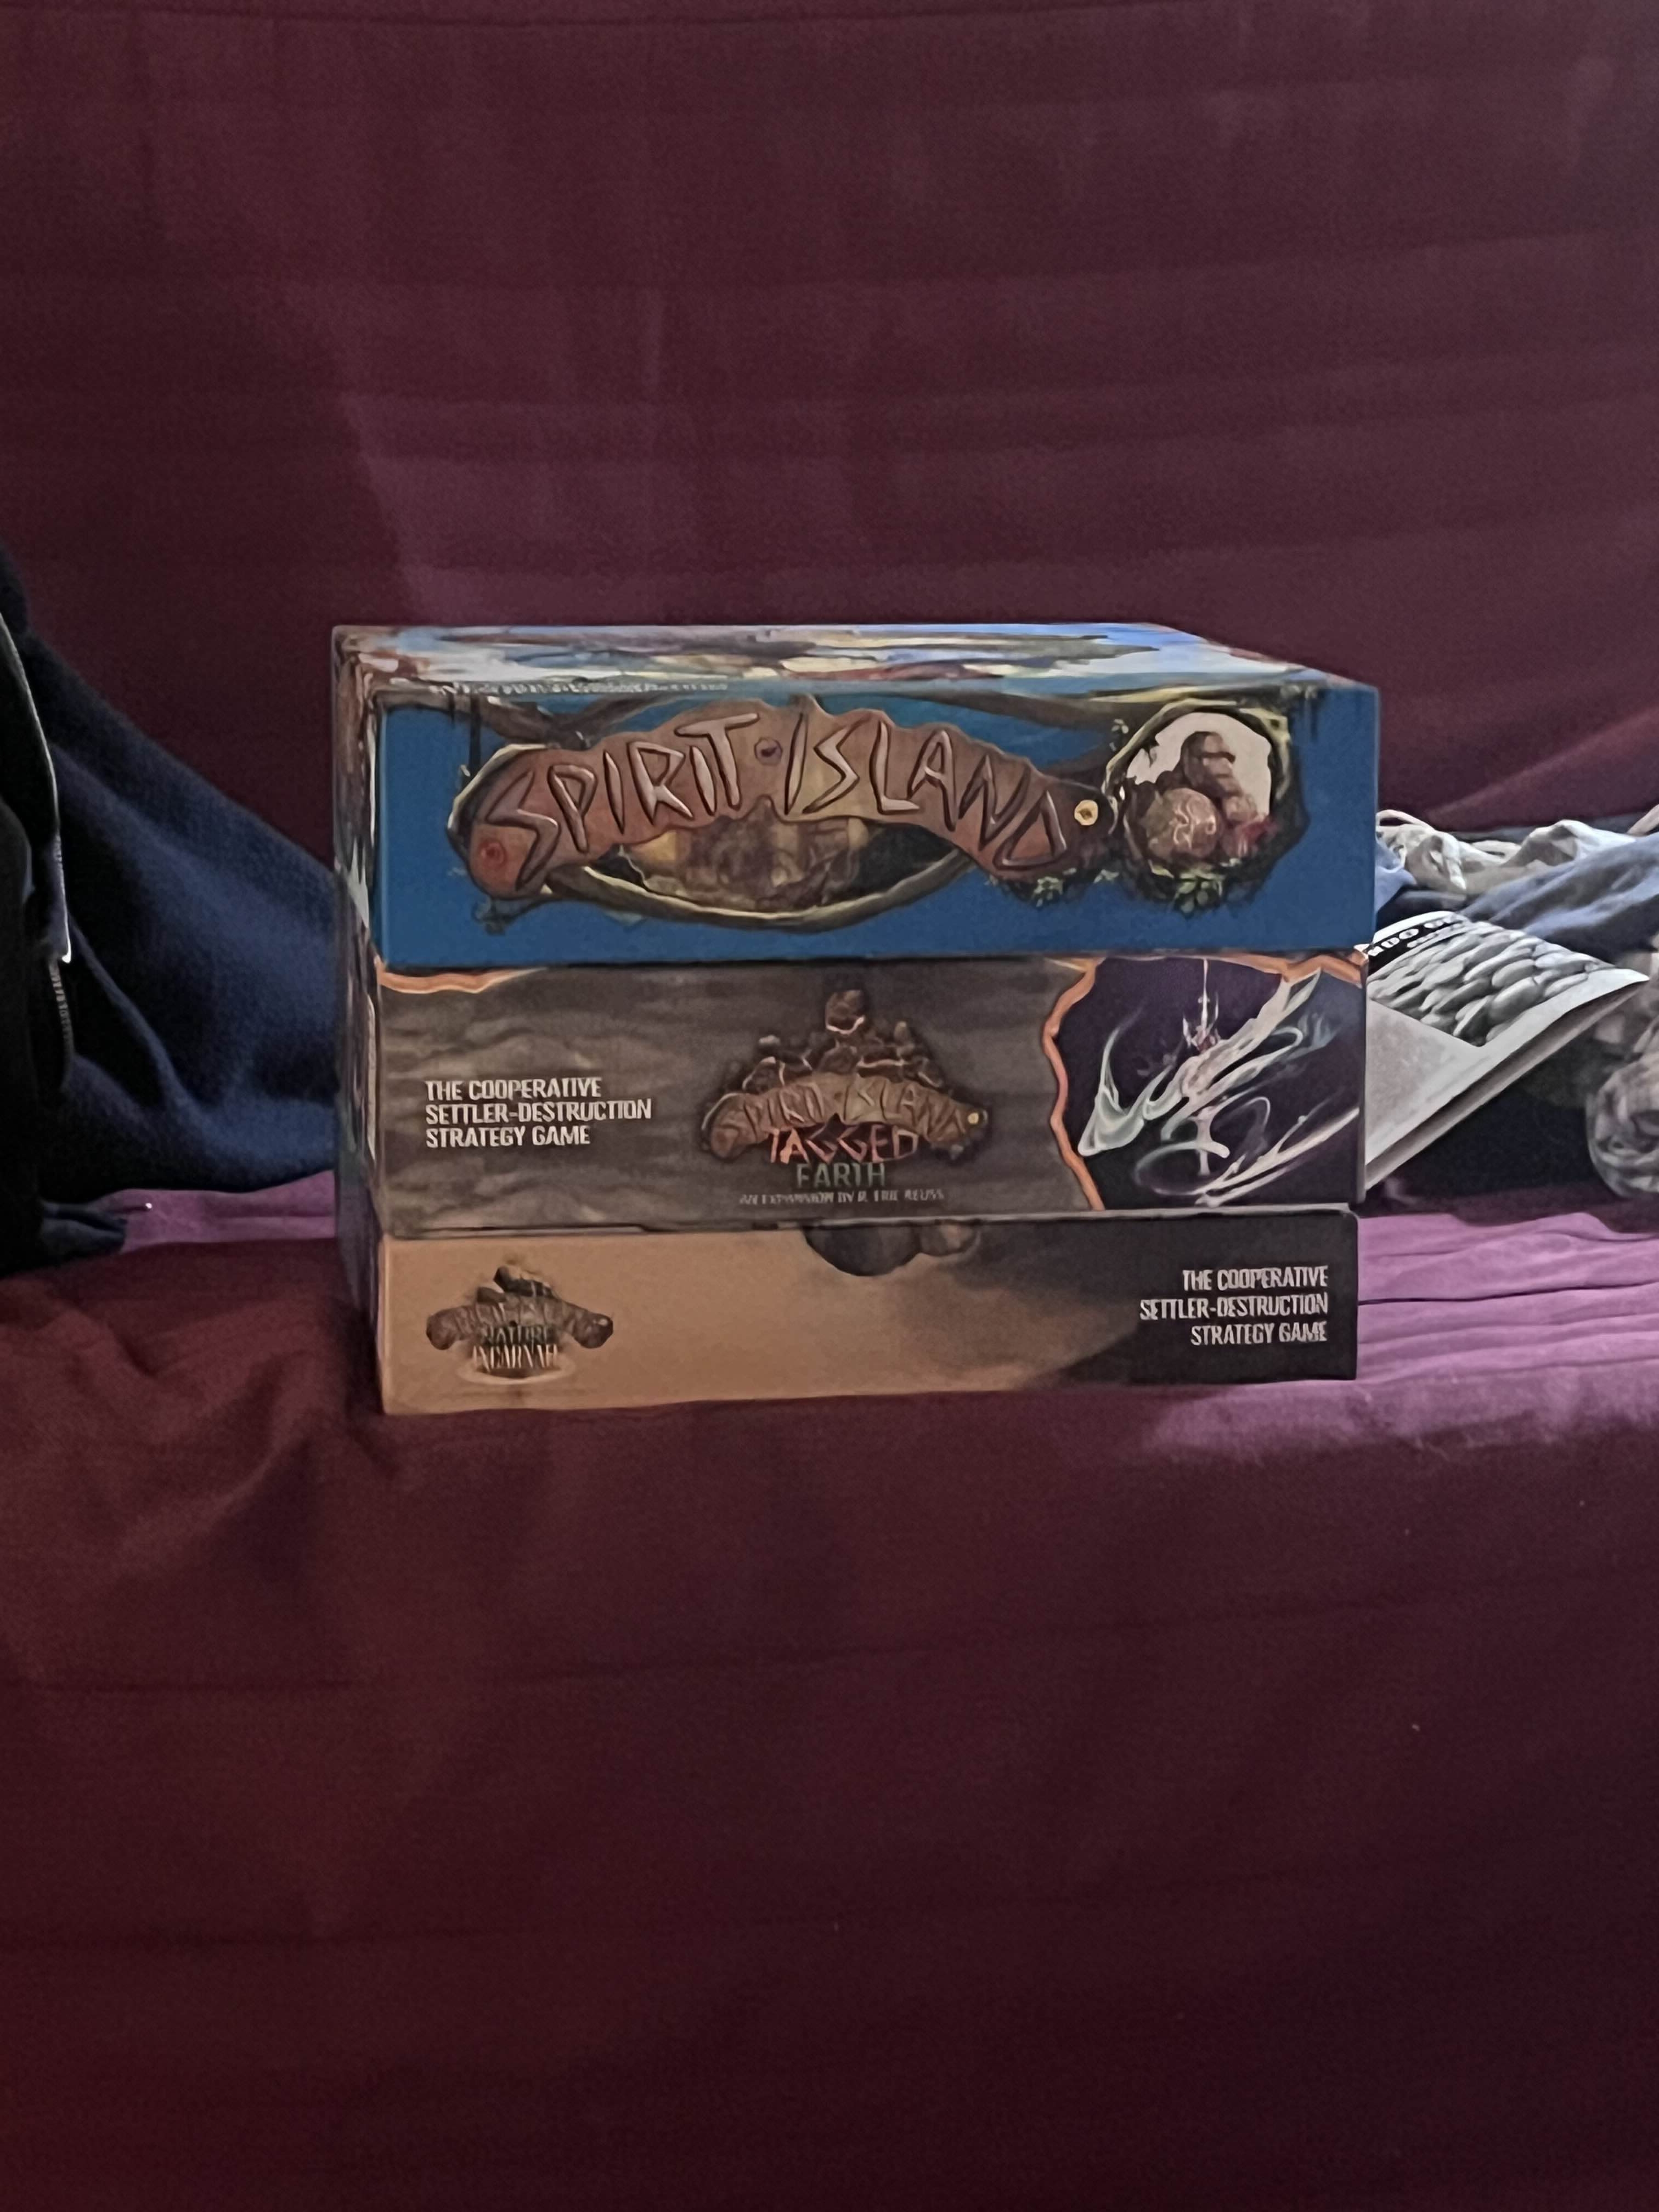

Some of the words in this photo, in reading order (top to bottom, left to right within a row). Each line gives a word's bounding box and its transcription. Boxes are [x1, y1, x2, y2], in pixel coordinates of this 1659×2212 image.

[485, 713, 758, 889] SPIRIT
[784, 713, 1067, 871] ISLAND
[425, 1080, 463, 1101] THE
[469, 1077, 602, 1101] COOPERATIVE
[425, 1098, 652, 1125] SETTLER-DESTRUCTION
[425, 1125, 526, 1148] STRATEGY
[532, 1125, 590, 1146] GAME
[796, 1162, 886, 1188] EARTH
[1182, 1269, 1212, 1291] THE
[1217, 1265, 1329, 1291] COOPERATIVE
[1139, 1292, 1328, 1321] SETTLER-DESTRUCTION
[1190, 1323, 1275, 1346] STRATEGY
[1278, 1321, 1328, 1343] GAME
